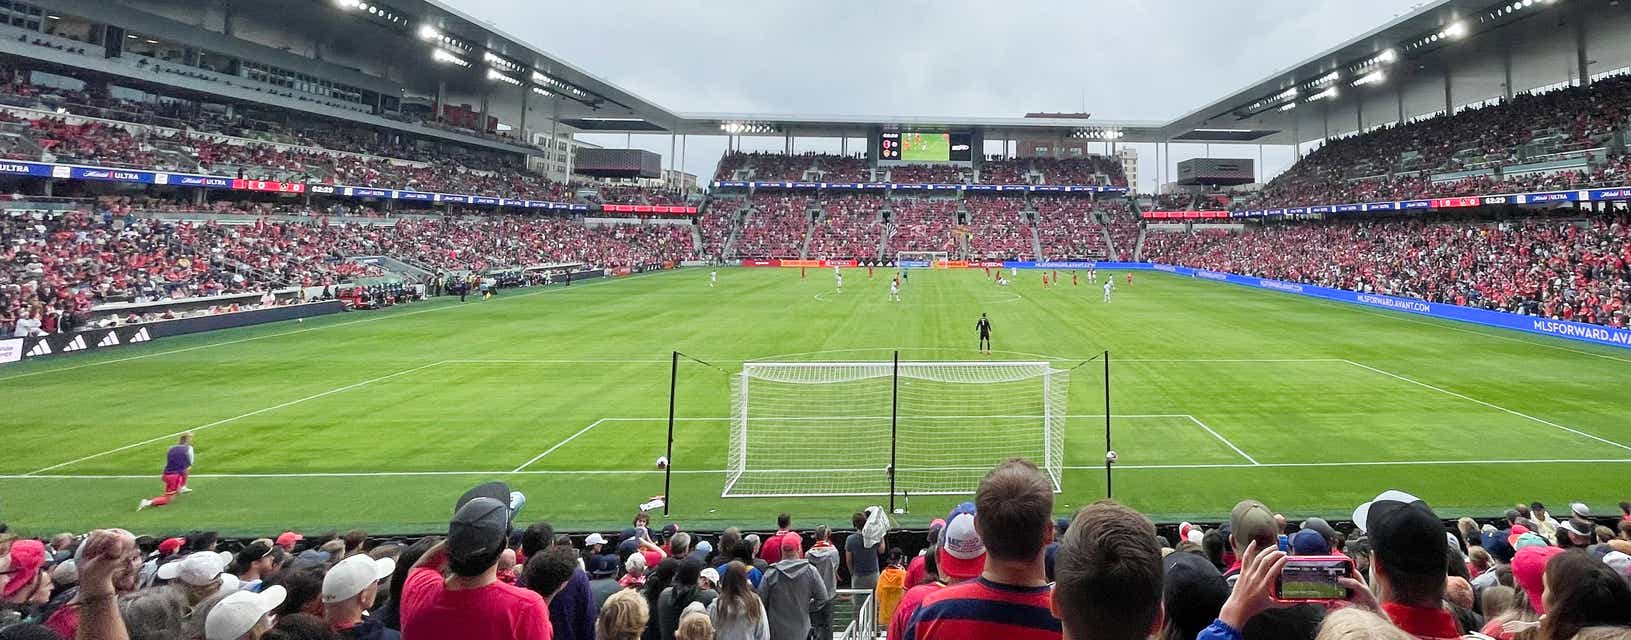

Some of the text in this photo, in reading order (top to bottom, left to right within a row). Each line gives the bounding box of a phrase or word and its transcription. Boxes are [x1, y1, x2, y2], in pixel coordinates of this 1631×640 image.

[0, 164, 30, 173] ULTRA
[114, 171, 139, 180] ULTRA
[206, 178, 226, 186] ULTRA
